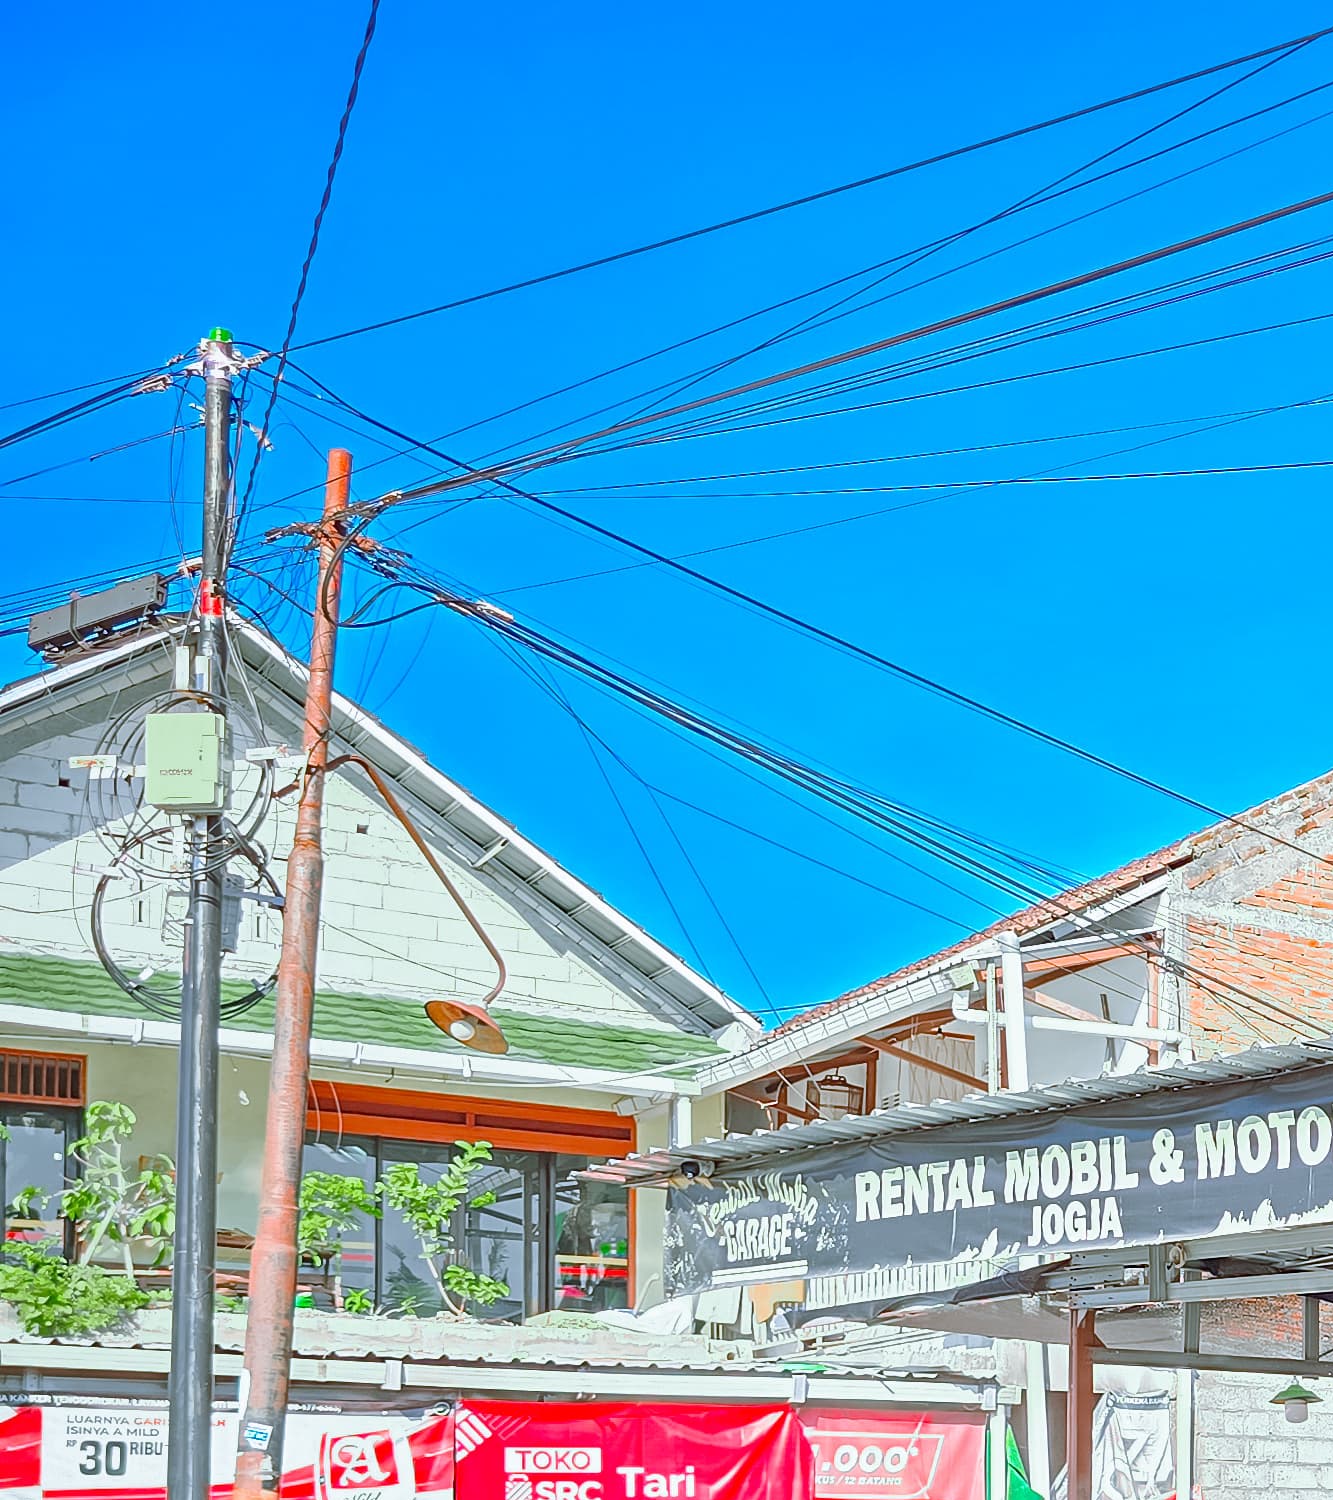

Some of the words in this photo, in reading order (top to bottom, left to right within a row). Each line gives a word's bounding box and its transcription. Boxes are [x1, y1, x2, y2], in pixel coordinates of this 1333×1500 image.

[855, 1156, 995, 1223] RENTAL
[1004, 1135, 1139, 1204] MOBIL
[1148, 1128, 1185, 1186] &
[722, 1213, 794, 1262] GARAGE
[1027, 1197, 1124, 1247] JOGJA
[66, 1415, 130, 1425] LUARNYA
[66, 1426, 109, 1436] ISINYA
[113, 1428, 122, 1436] A
[126, 1428, 160, 1437] MILD
[79, 1440, 128, 1476] 30
[515, 1450, 592, 1471] TOKO
[615, 1465, 696, 1498] Tari
